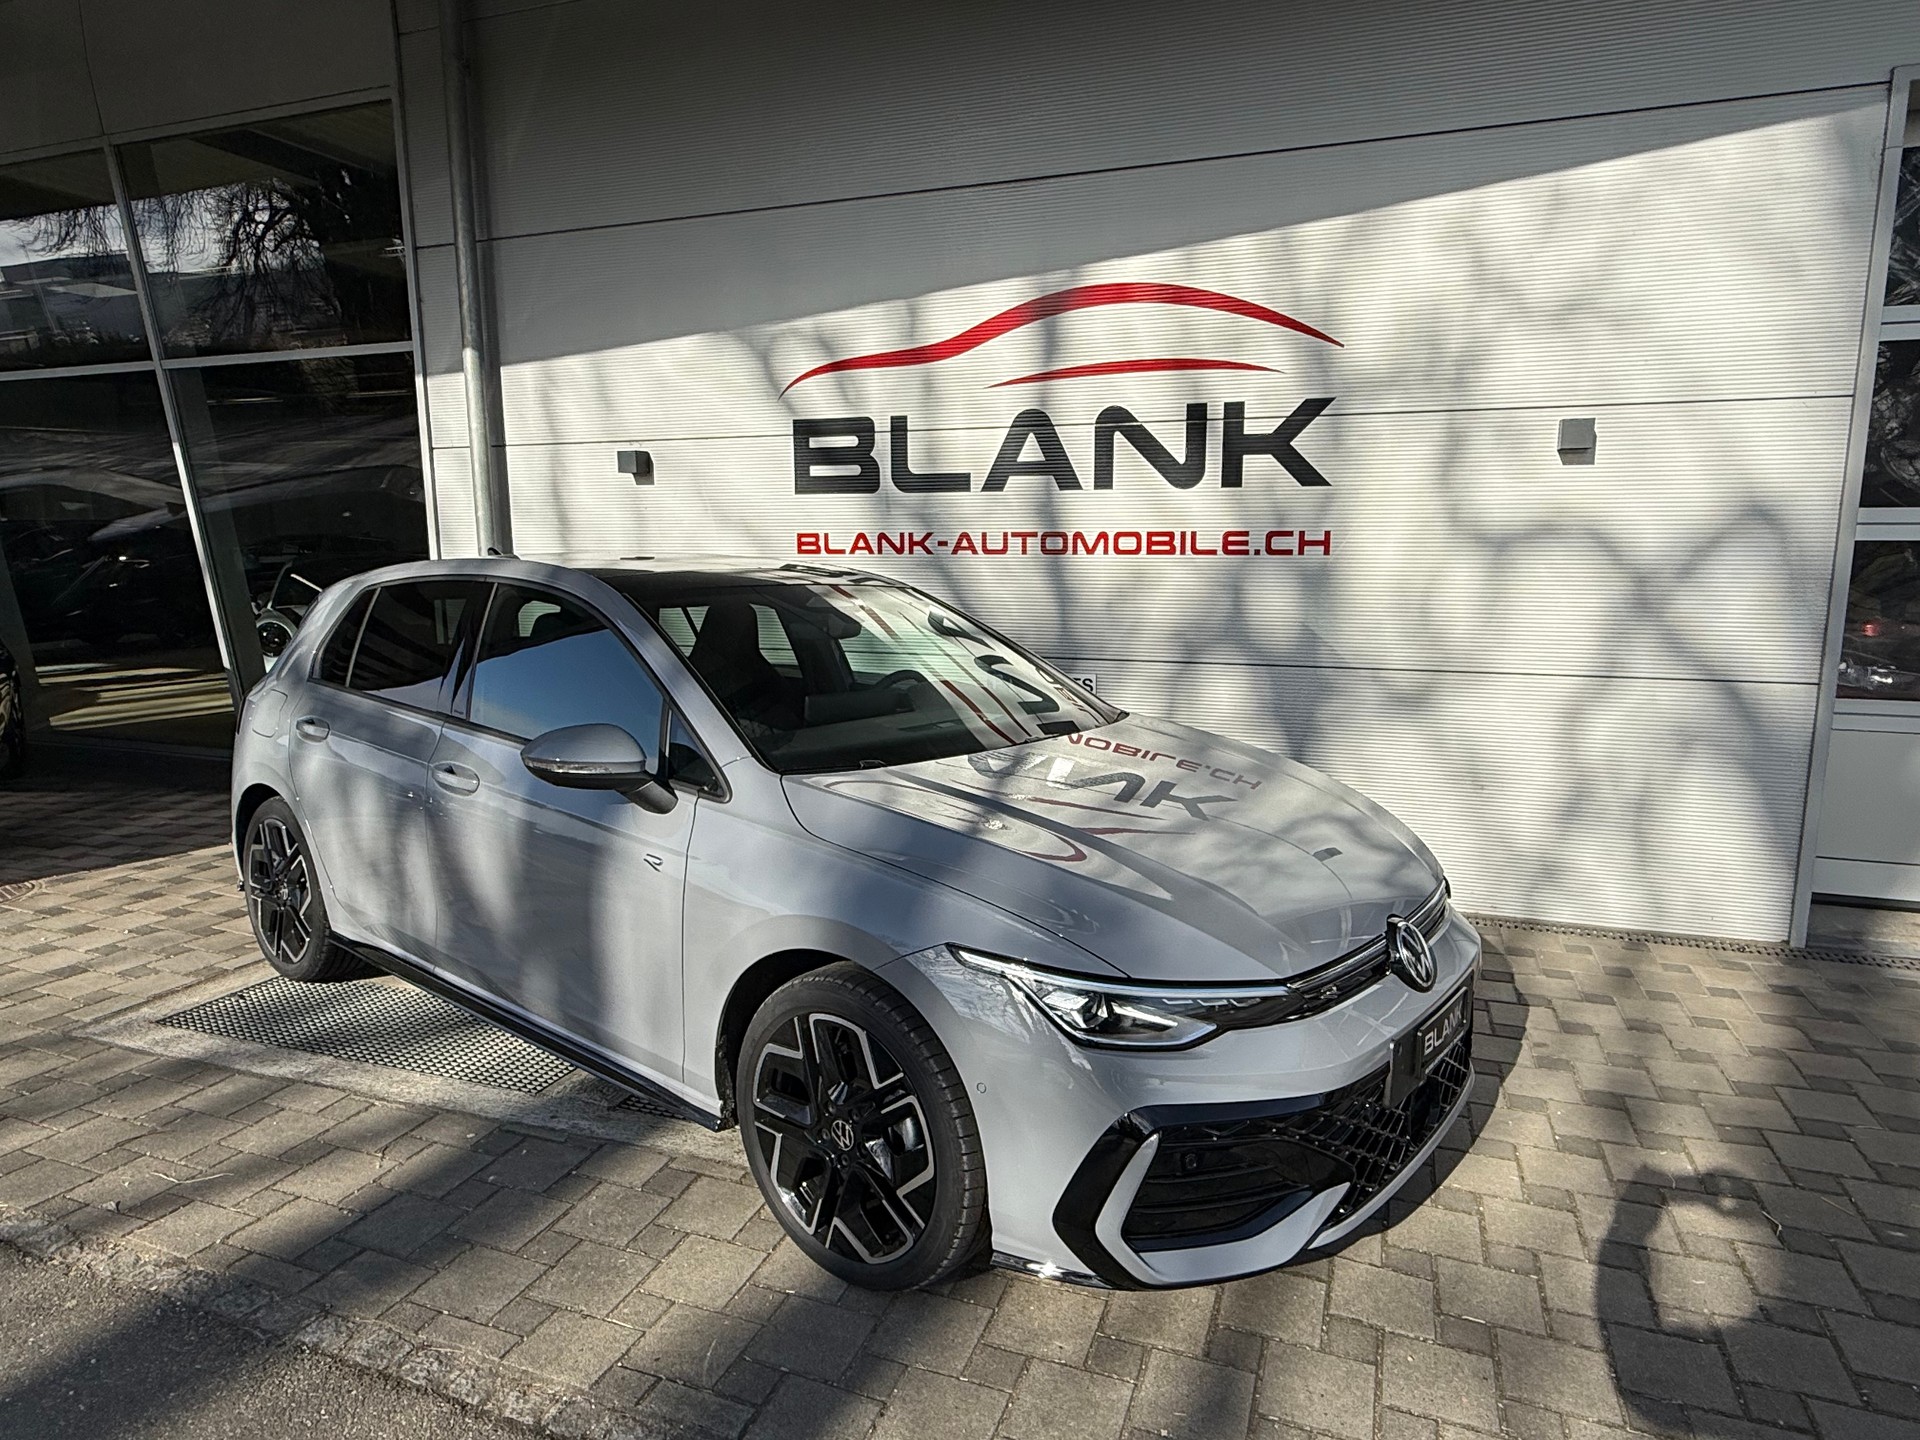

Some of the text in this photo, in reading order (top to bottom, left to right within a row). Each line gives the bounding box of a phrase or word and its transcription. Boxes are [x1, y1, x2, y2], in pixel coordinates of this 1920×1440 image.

[792, 397, 1337, 495] BLANK
[796, 530, 1332, 556] BLANK-AUTOMOBILE.CH
[1424, 1000, 1463, 1056] BLANK
